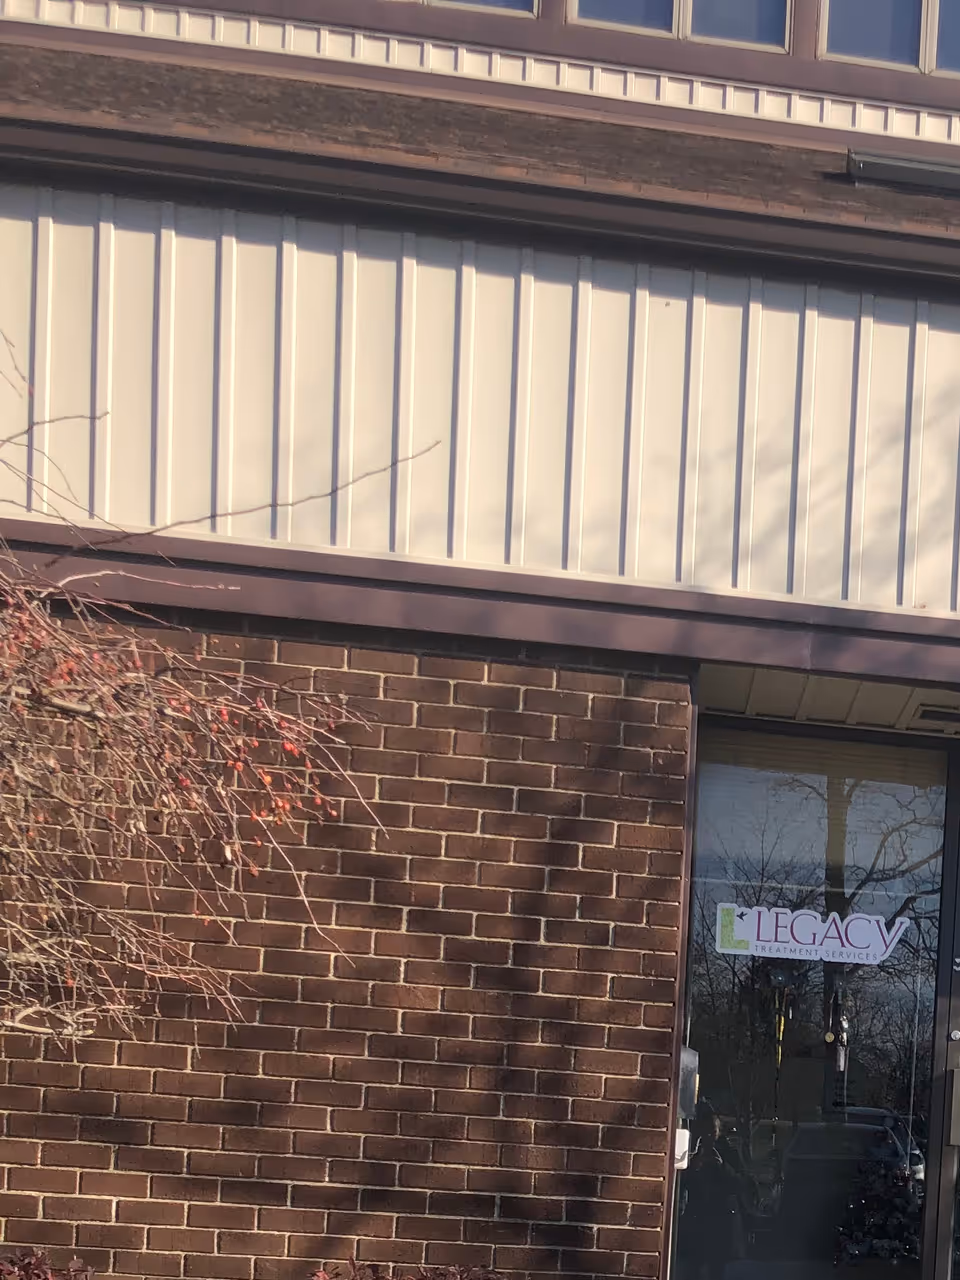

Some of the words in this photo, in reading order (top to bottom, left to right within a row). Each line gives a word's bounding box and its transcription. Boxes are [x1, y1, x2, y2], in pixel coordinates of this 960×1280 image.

[755, 910, 904, 956] LEGACY
[754, 944, 819, 957] TREATMENT
[825, 950, 879, 961] SERVICES
